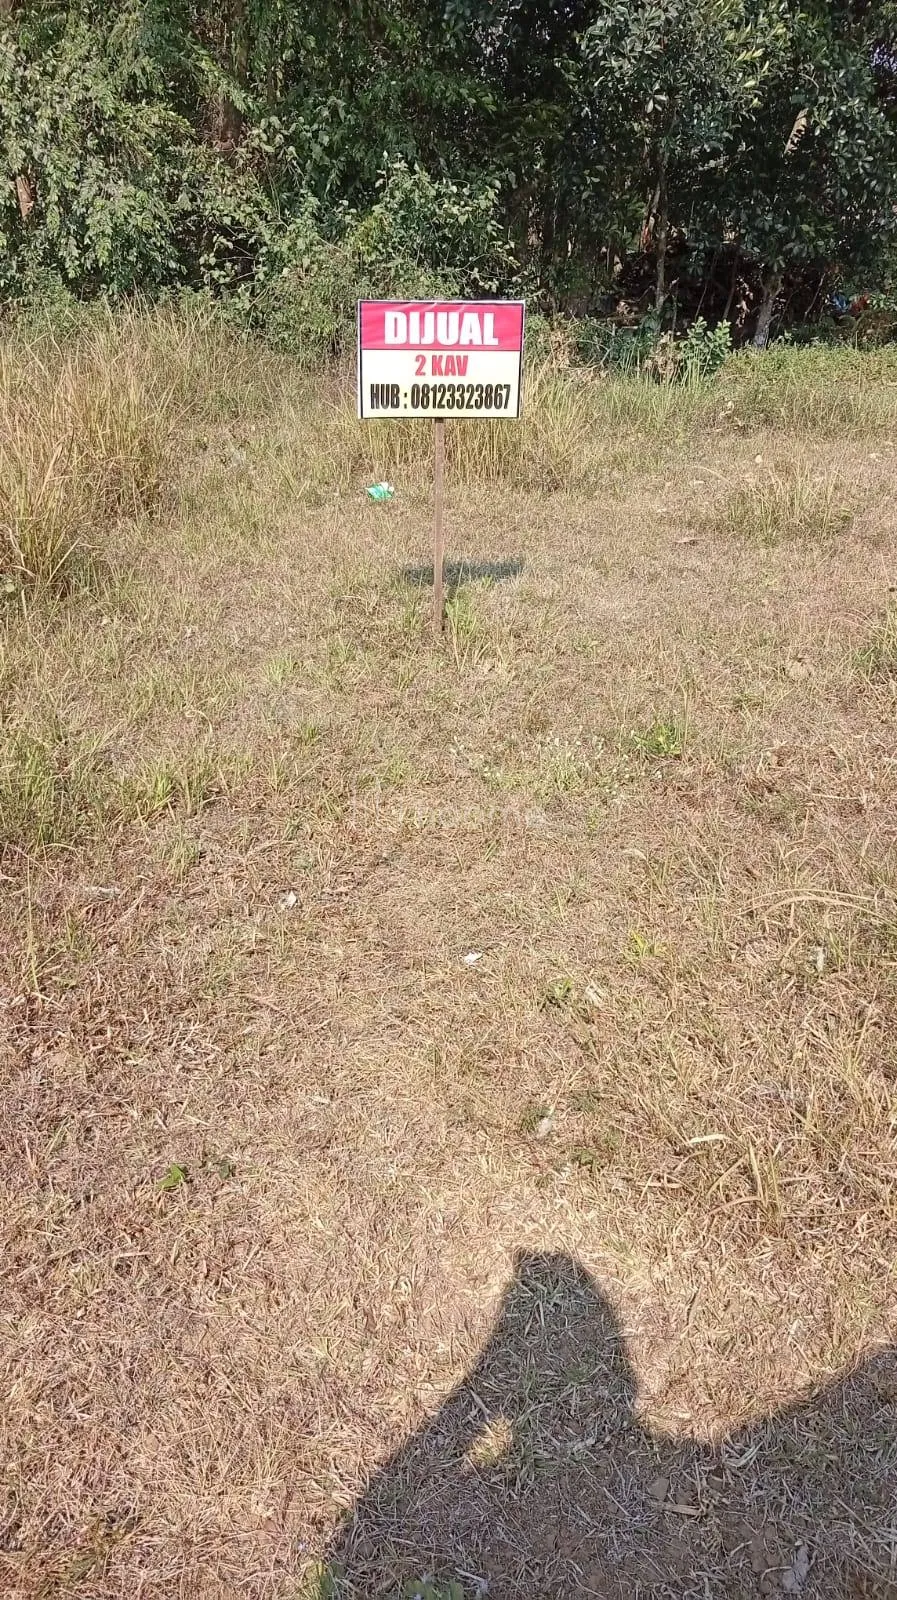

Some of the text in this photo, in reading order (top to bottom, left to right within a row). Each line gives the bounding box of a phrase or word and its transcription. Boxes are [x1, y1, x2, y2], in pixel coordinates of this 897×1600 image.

[384, 311, 499, 346] DIJUAL
[414, 354, 469, 377] 2 KAV
[370, 383, 400, 410] HUB
[410, 383, 511, 410] 08123323867
